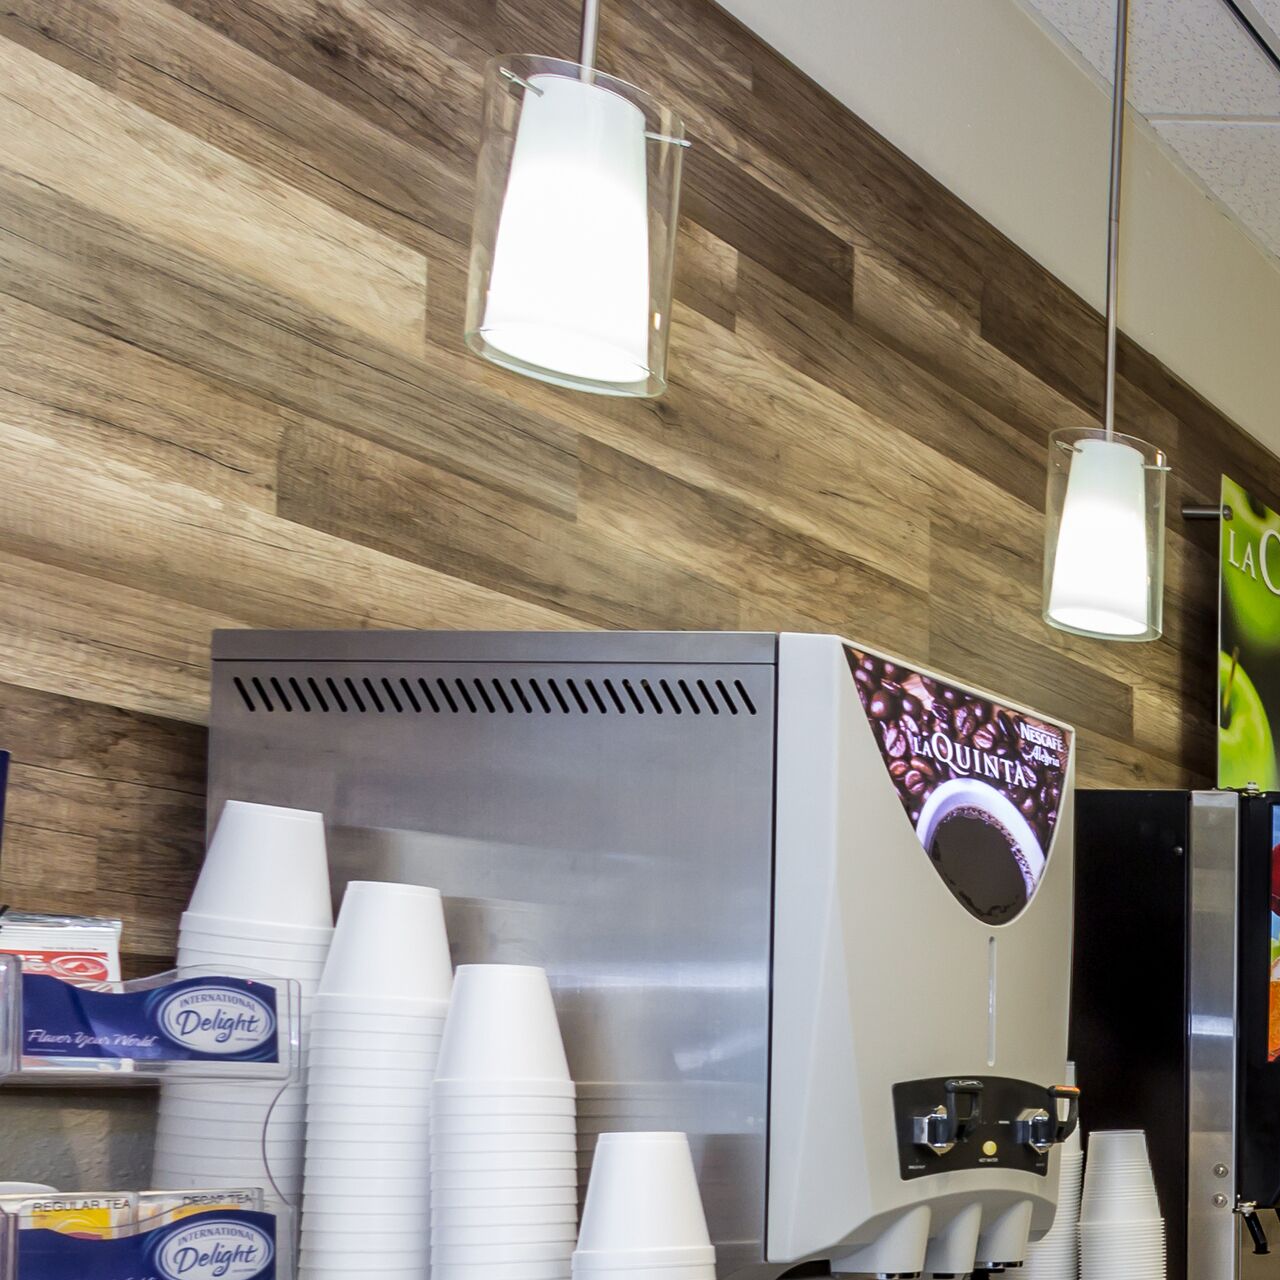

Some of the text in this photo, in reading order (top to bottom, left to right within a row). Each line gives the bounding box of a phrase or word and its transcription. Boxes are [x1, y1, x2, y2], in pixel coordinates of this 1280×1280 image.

[930, 731, 1028, 789] QUINTA
[179, 993, 256, 1011] INTERNATIONAL
[176, 1008, 260, 1043] Delight
[27, 1029, 159, 1049] Flavor Your World
[32, 1199, 132, 1213] REGULAR TEA
[227, 1193, 253, 1205] TEA
[177, 1227, 255, 1247] INTERNATIONAL
[173, 1242, 258, 1277] Delight
